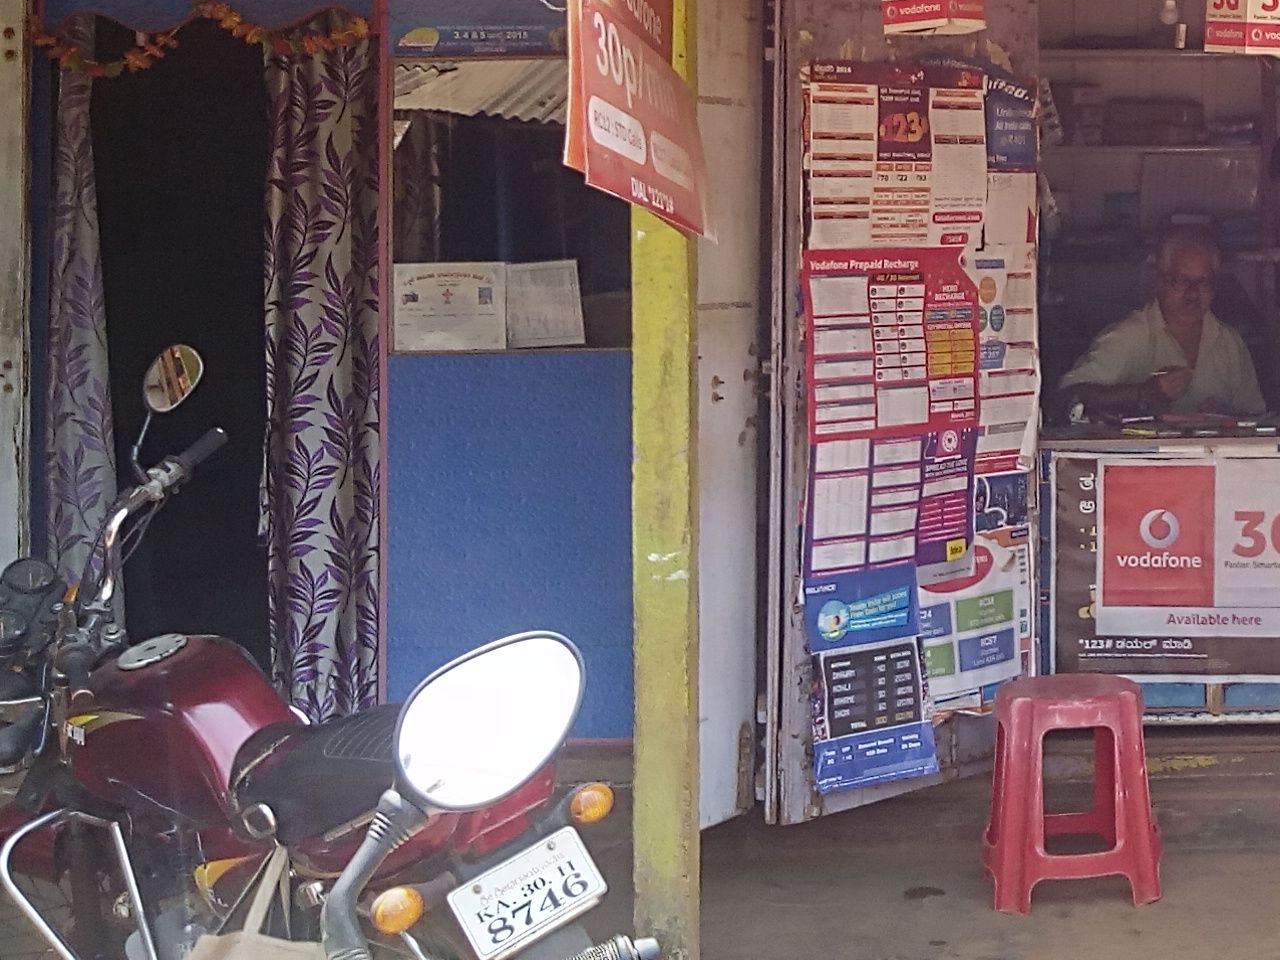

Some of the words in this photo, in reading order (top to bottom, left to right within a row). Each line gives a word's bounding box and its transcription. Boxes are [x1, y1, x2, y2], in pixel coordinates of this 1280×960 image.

[899, 3, 941, 15] vodafone
[810, 261, 849, 271] Vodafone
[850, 259, 883, 270] Prepaid
[884, 260, 919, 270] Recharge
[1117, 552, 1202, 568] vodafone
[1166, 613, 1229, 626] Available
[1231, 613, 1263, 626] here
[487, 872, 589, 945] 8746
